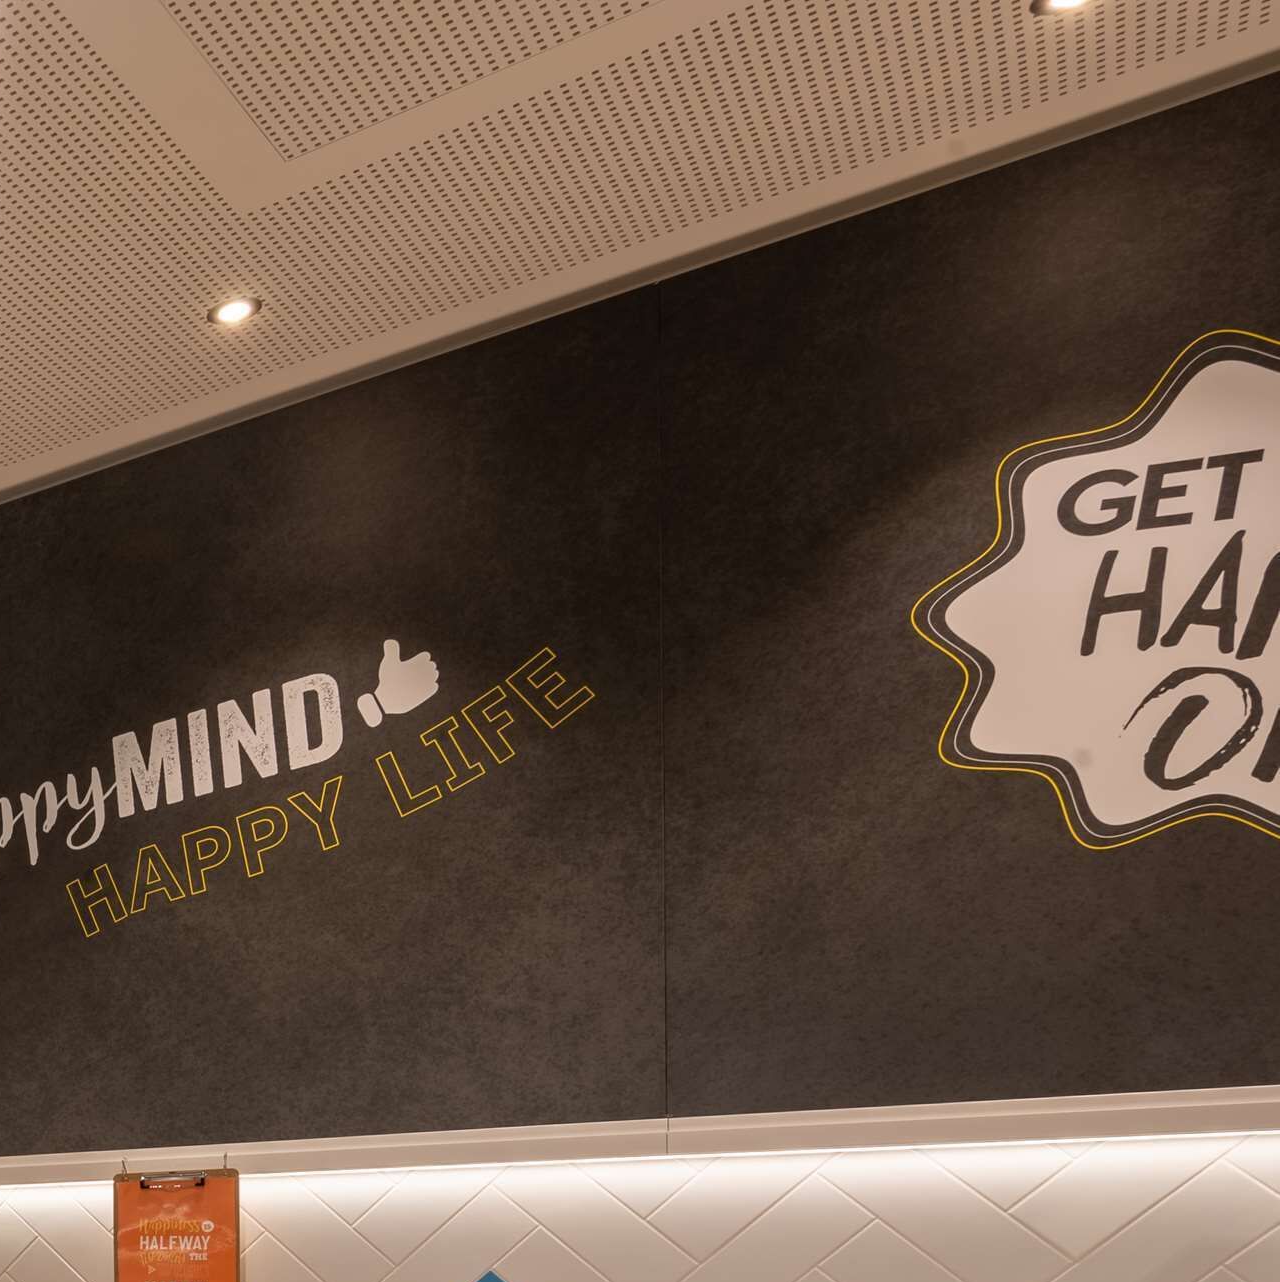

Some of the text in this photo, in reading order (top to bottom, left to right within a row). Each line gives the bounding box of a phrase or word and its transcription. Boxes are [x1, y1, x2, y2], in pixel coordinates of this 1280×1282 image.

[1057, 449, 1265, 536] GET
[65, 647, 596, 938] HAPPY LIFE
[139, 1235, 210, 1250] HALFWAY
